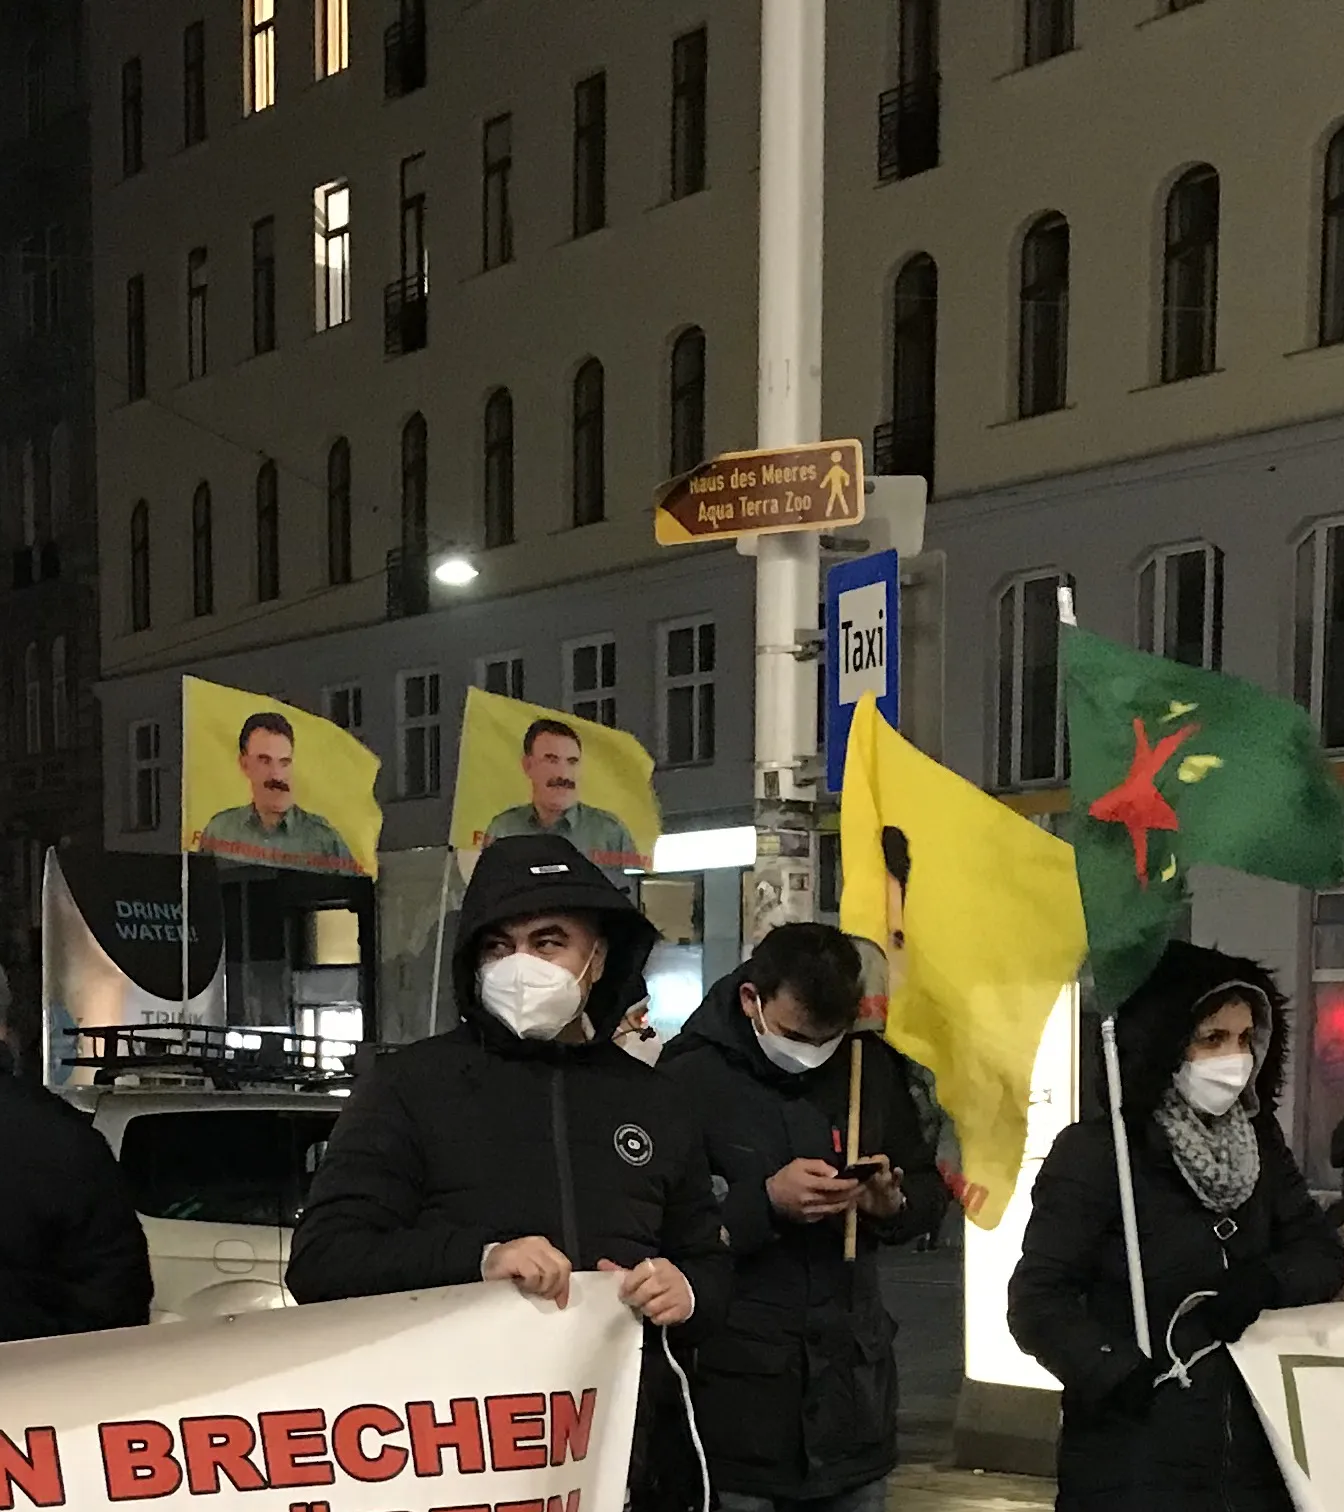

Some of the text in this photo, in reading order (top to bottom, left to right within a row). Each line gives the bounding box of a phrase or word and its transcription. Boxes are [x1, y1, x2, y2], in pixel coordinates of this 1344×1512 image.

[730, 467, 757, 490] des
[761, 463, 817, 486] Meeres
[697, 491, 812, 529] Aqua Terra Zoo
[840, 609, 885, 675] Taxi
[115, 899, 183, 920] DRINK
[99, 1387, 597, 1502] BRECHEN
